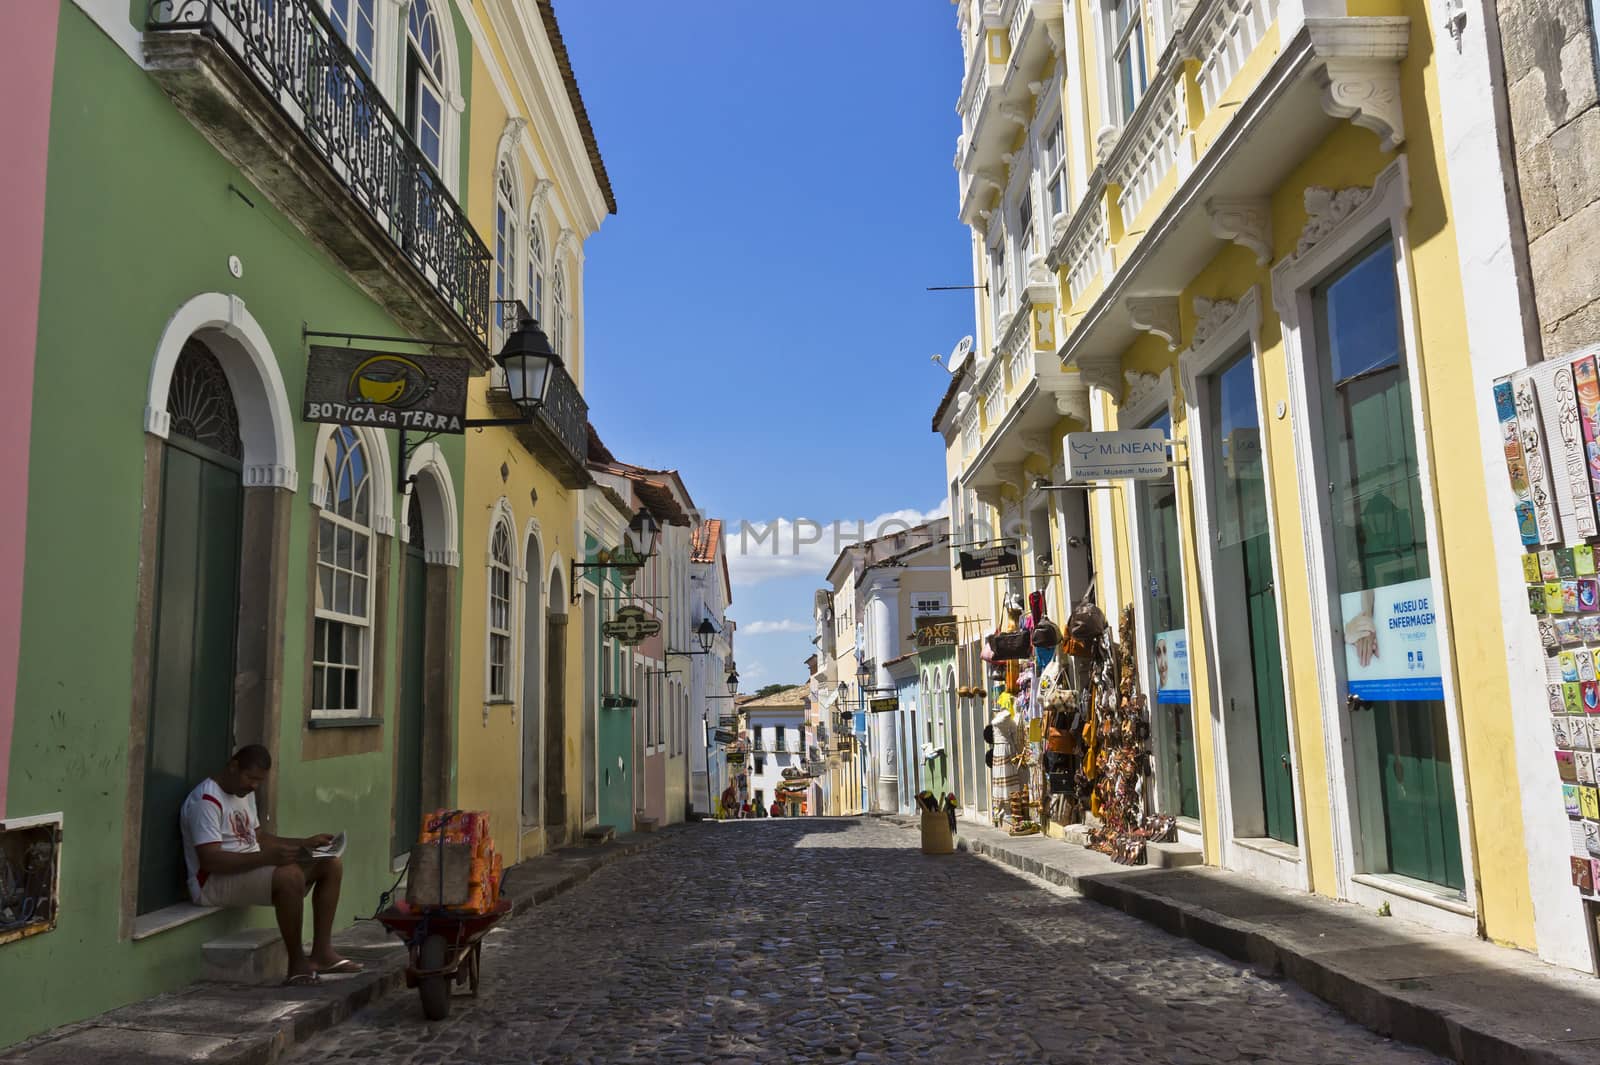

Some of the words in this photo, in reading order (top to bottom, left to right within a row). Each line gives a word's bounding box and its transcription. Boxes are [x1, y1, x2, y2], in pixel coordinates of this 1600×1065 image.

[307, 402, 377, 423] BOTICA
[379, 410, 397, 424] da
[400, 410, 462, 431] TERRA
[1076, 468, 1099, 478] Museu
[1103, 466, 1135, 476] Museum
[1138, 465, 1163, 474] Museo
[1393, 600, 1417, 614] MUSEU
[1418, 598, 1429, 610] DE
[1388, 612, 1436, 630] ENFERMAGEM
